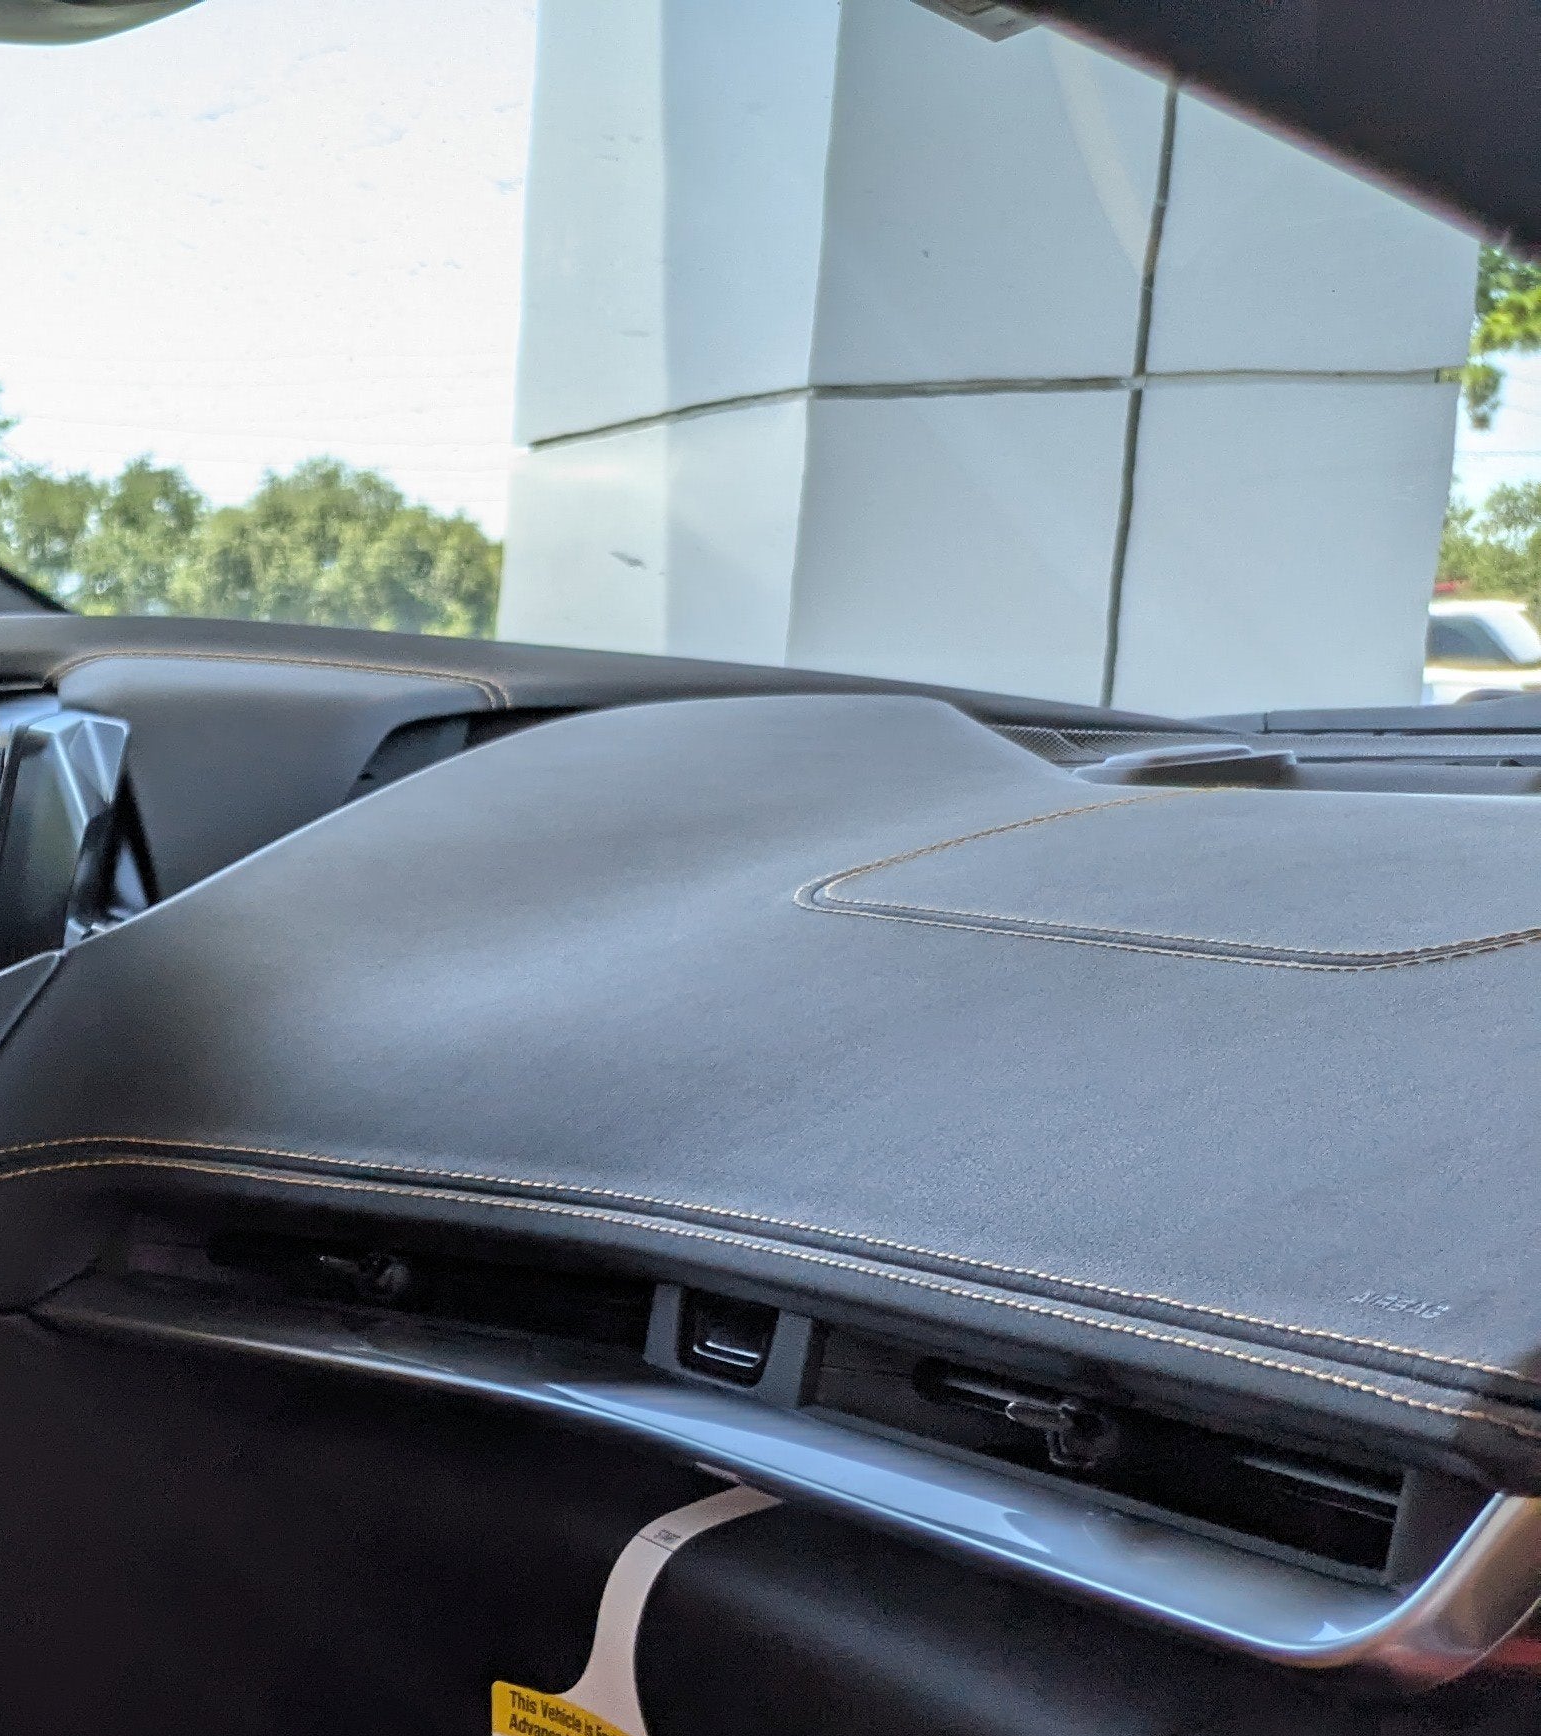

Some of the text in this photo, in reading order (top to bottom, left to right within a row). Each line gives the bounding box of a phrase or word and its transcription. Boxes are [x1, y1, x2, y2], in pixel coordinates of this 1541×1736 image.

[1343, 1290, 1450, 1319] AIRBAG
[509, 1690, 537, 1715] This
[540, 1699, 582, 1733] Vehicle
